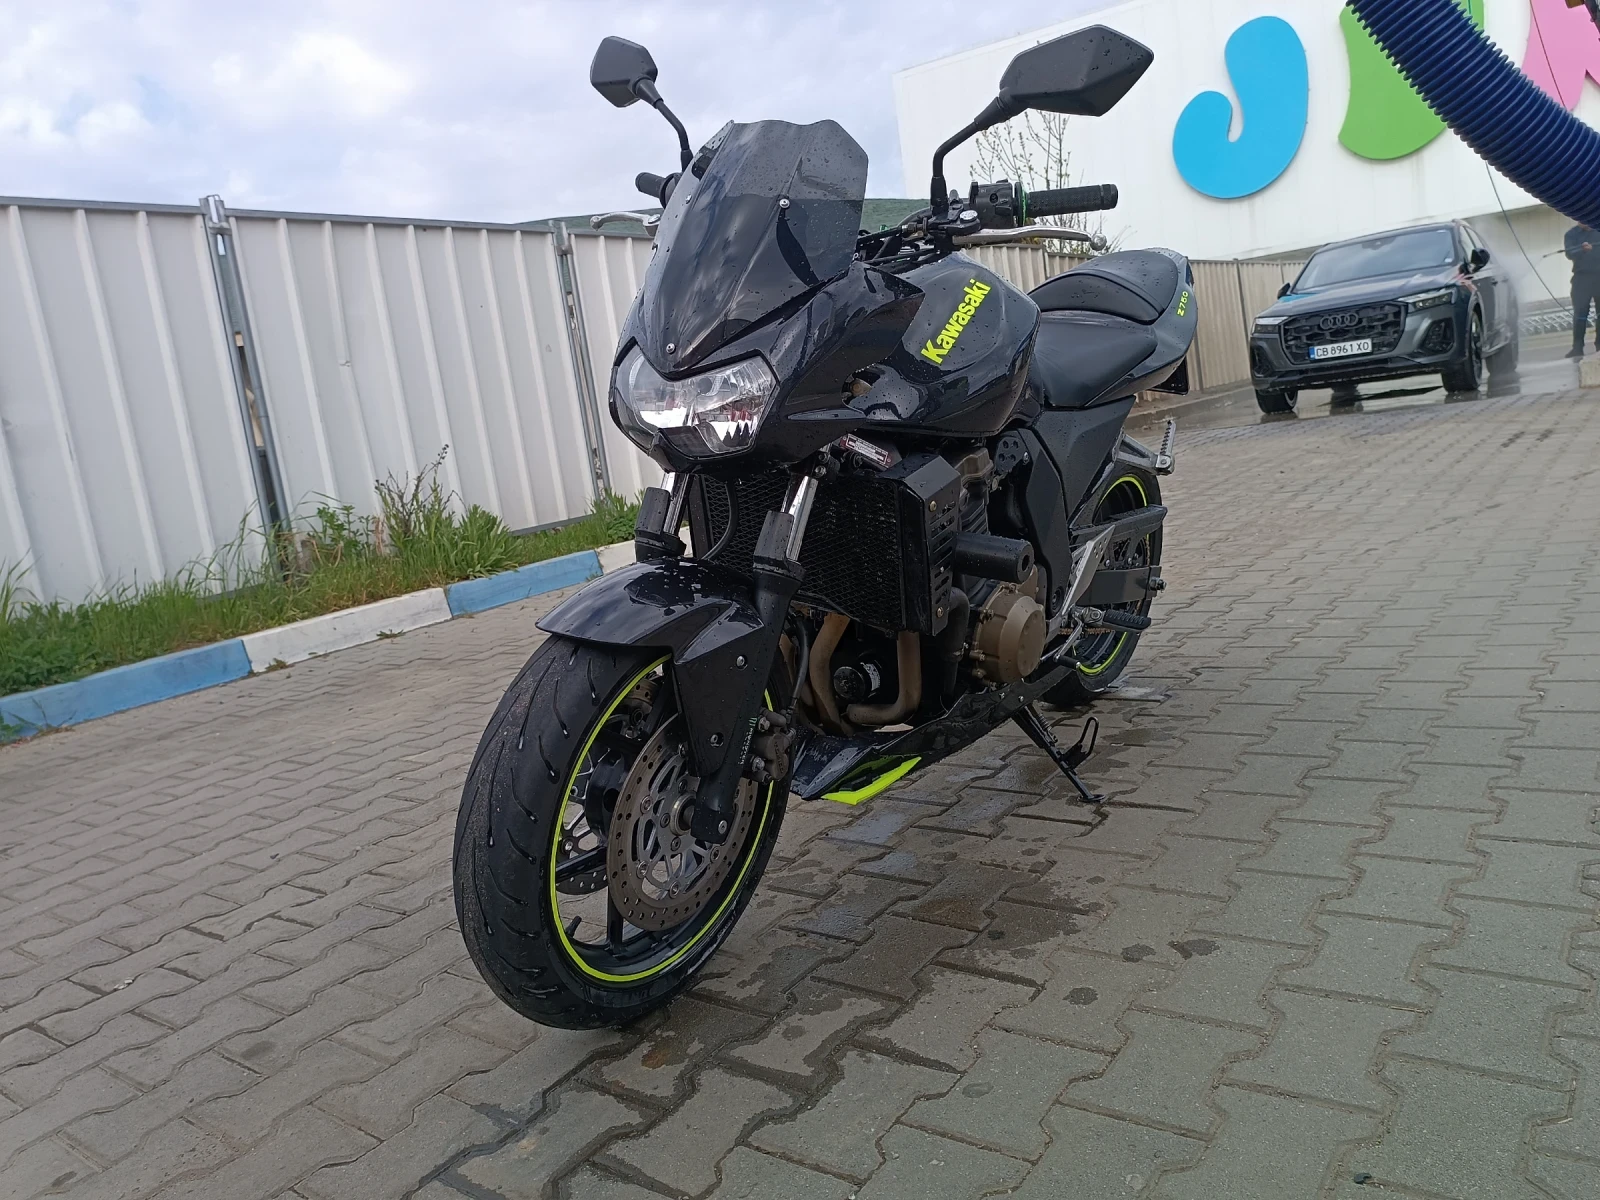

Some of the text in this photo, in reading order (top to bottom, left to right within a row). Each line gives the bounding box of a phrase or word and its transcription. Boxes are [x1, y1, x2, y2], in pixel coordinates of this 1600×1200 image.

[1177, 291, 1188, 317] Z750
[920, 278, 991, 364] Kawasaki
[1316, 342, 1369, 357] CB 8961 XO
